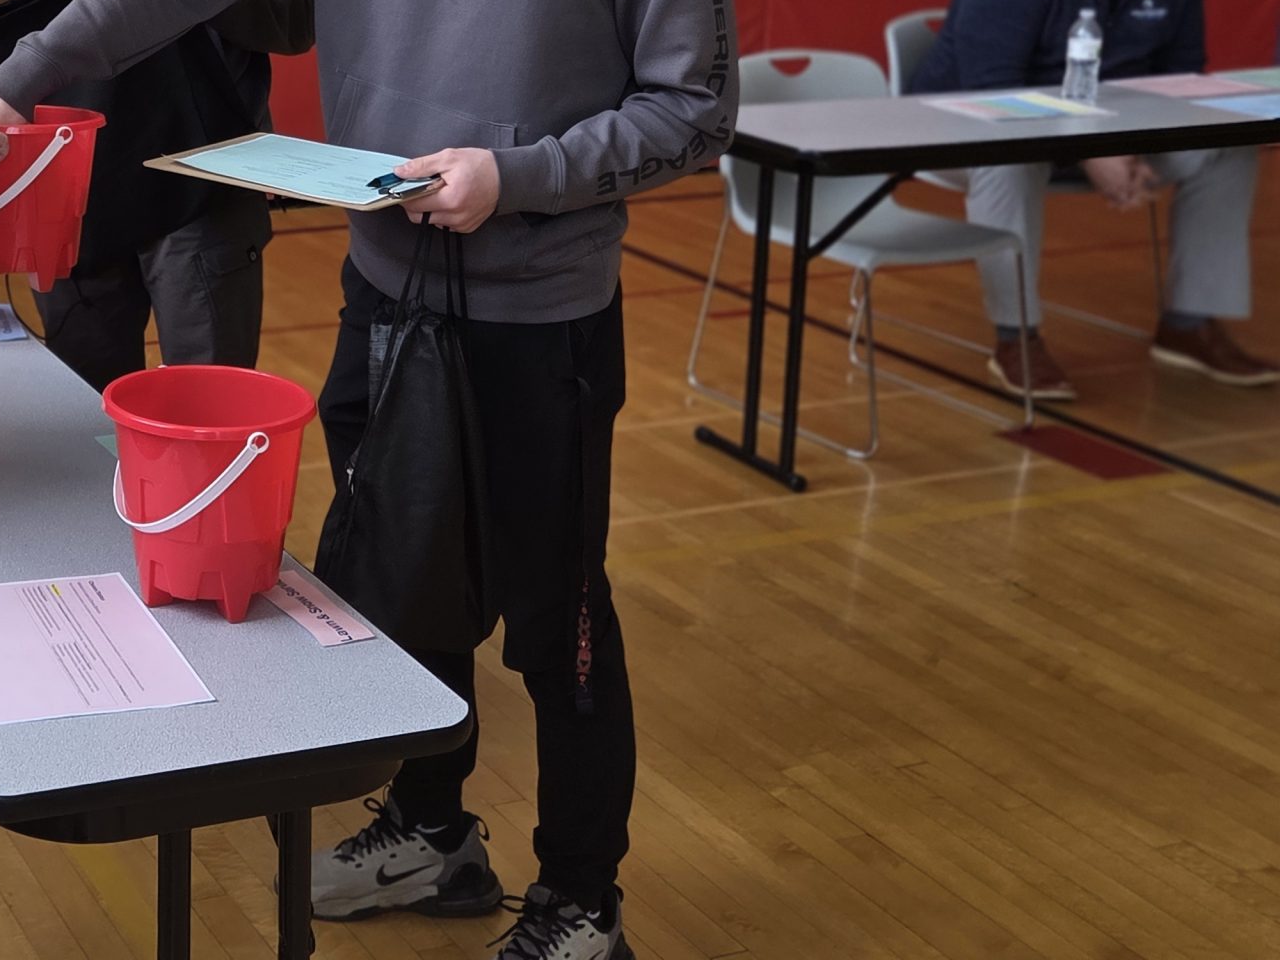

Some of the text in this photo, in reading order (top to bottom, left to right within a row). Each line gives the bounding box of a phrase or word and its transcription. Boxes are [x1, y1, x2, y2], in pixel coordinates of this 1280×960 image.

[596, 131, 707, 196] EAGLE
[295, 595, 322, 614] Snow
[326, 620, 353, 642] Lawn
